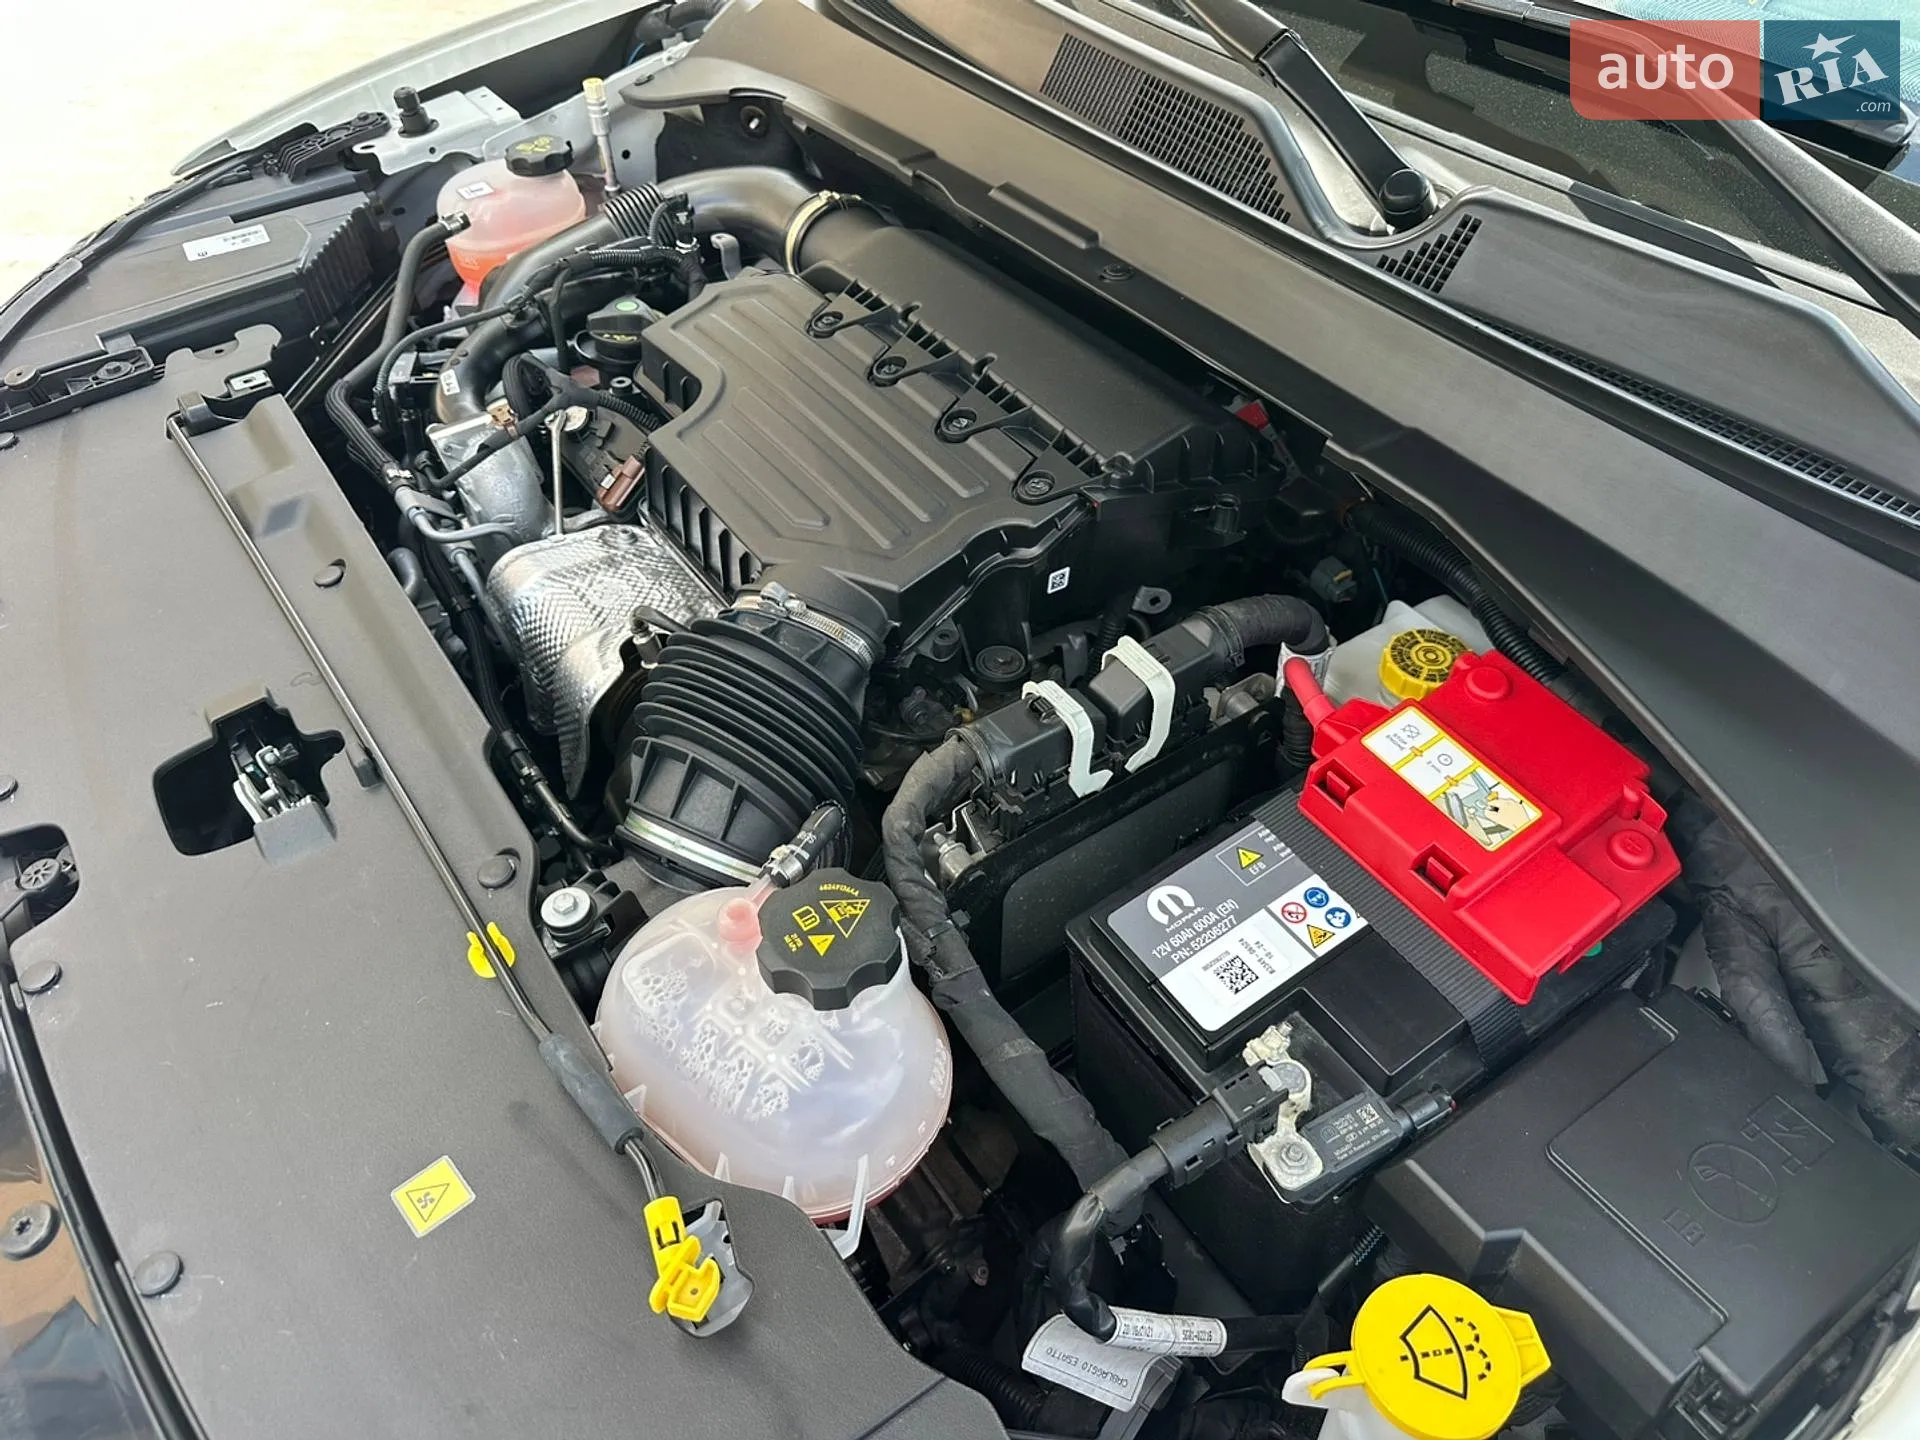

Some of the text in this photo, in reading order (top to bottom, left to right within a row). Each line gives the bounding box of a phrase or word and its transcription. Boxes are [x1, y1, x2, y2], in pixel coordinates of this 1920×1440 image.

[1152, 898, 1240, 959] 12V 60Ah 600A (EN)
[1170, 947, 1193, 964] PN:
[1190, 914, 1238, 951] 52206277
